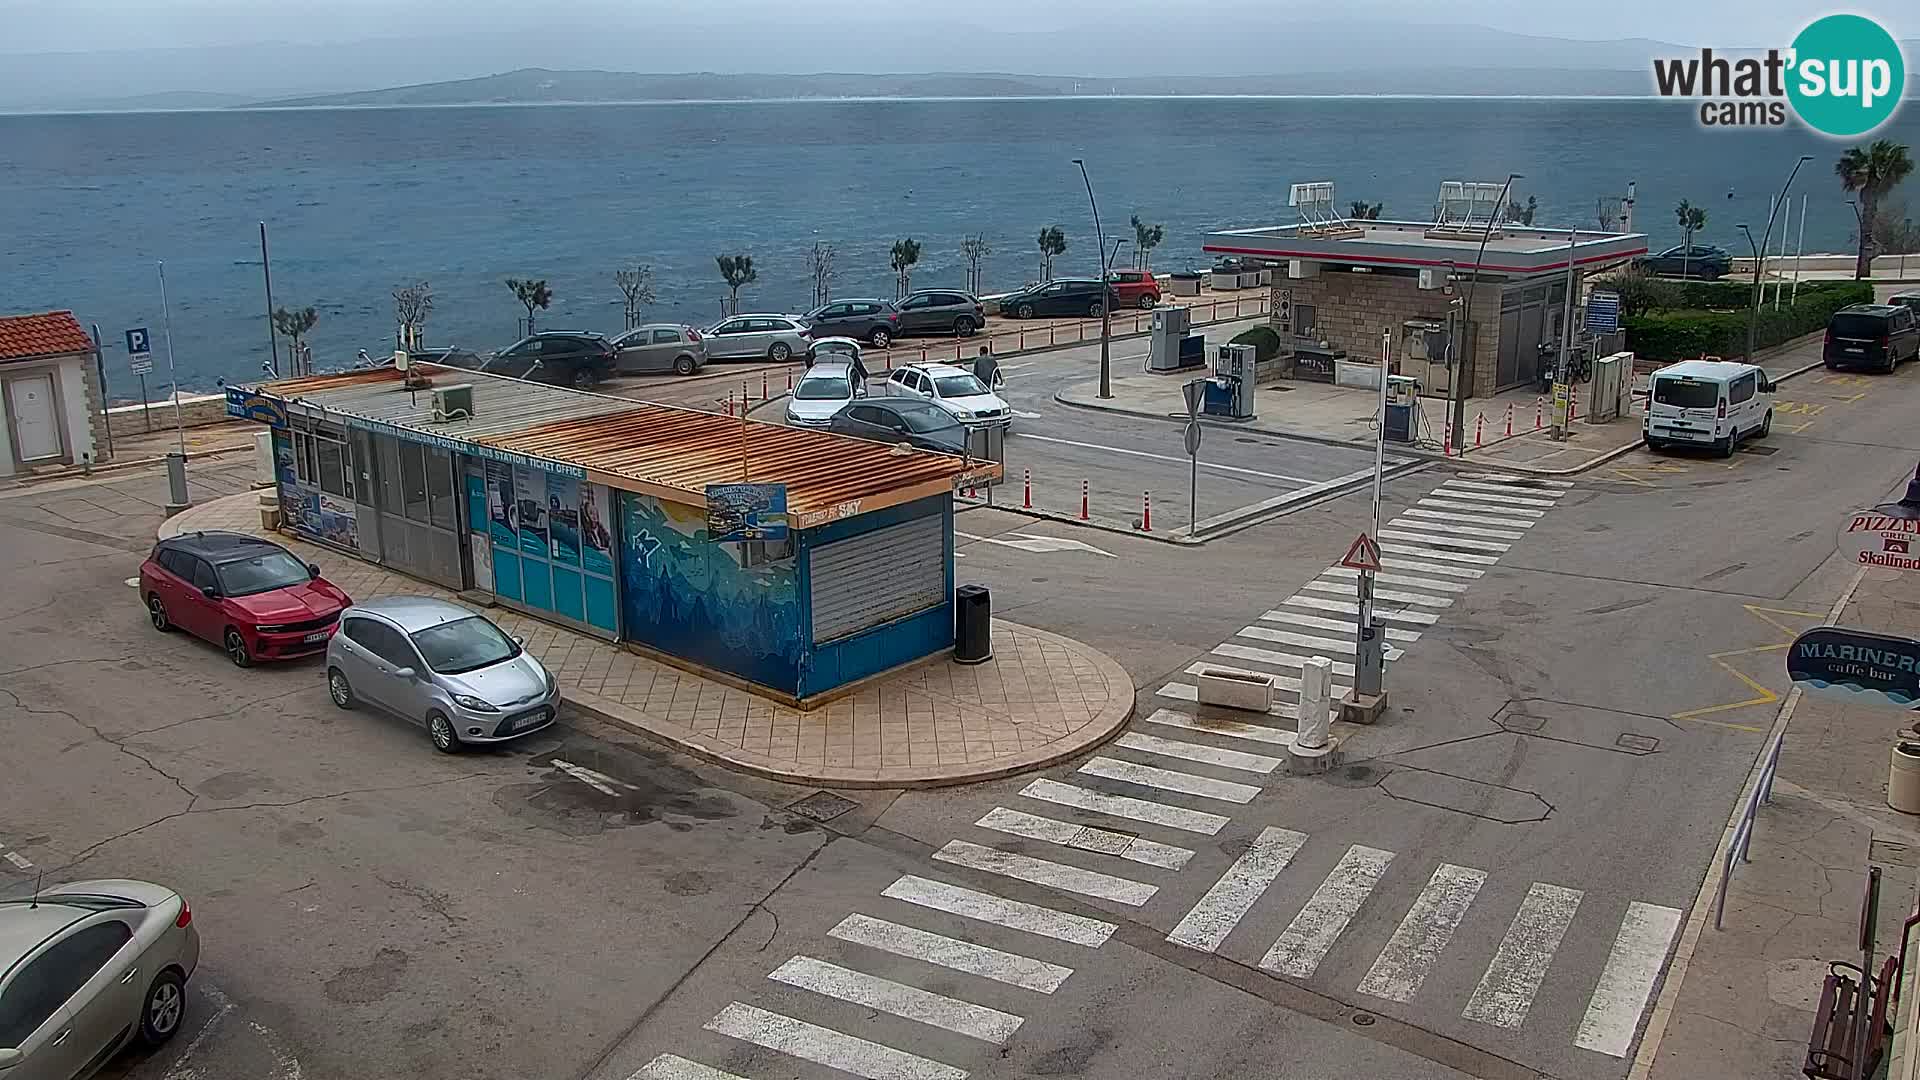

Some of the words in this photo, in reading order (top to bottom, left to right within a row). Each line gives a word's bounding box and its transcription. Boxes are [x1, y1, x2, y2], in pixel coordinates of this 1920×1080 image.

[131, 332, 144, 350] P
[437, 439, 468, 452] POSTAJA
[478, 446, 493, 458] BUS
[495, 450, 527, 464] STATION
[529, 458, 554, 472] TICKET
[556, 464, 583, 478] OFFICE
[1847, 516, 1920, 534] PIZZE
[1869, 666, 1896, 680] bar
